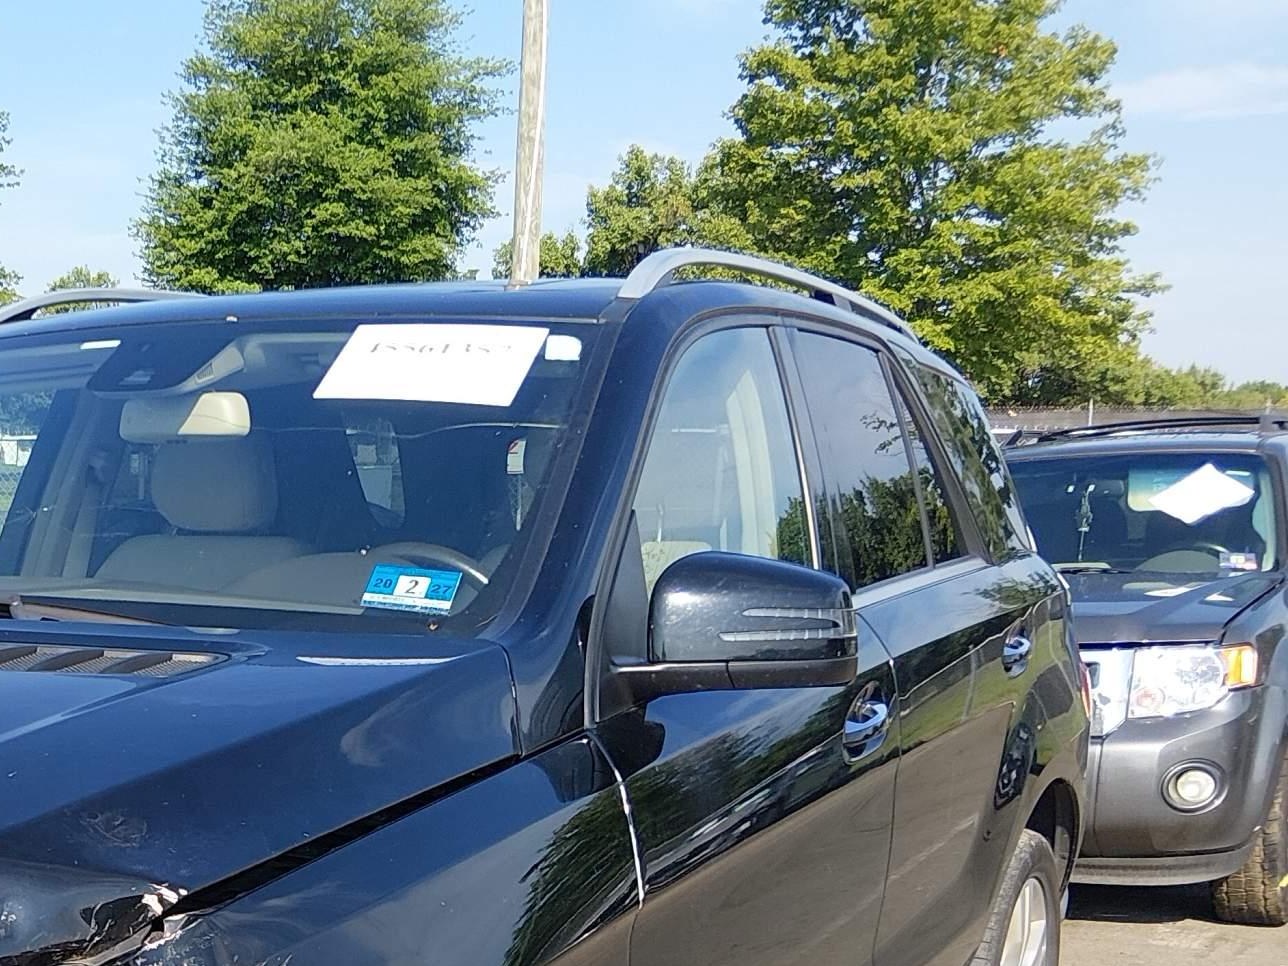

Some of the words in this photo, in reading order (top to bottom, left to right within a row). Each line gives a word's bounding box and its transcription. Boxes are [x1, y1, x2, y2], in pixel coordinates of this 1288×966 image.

[373, 577, 393, 589] 20
[404, 579, 419, 595] 2
[431, 584, 453, 595] 27
